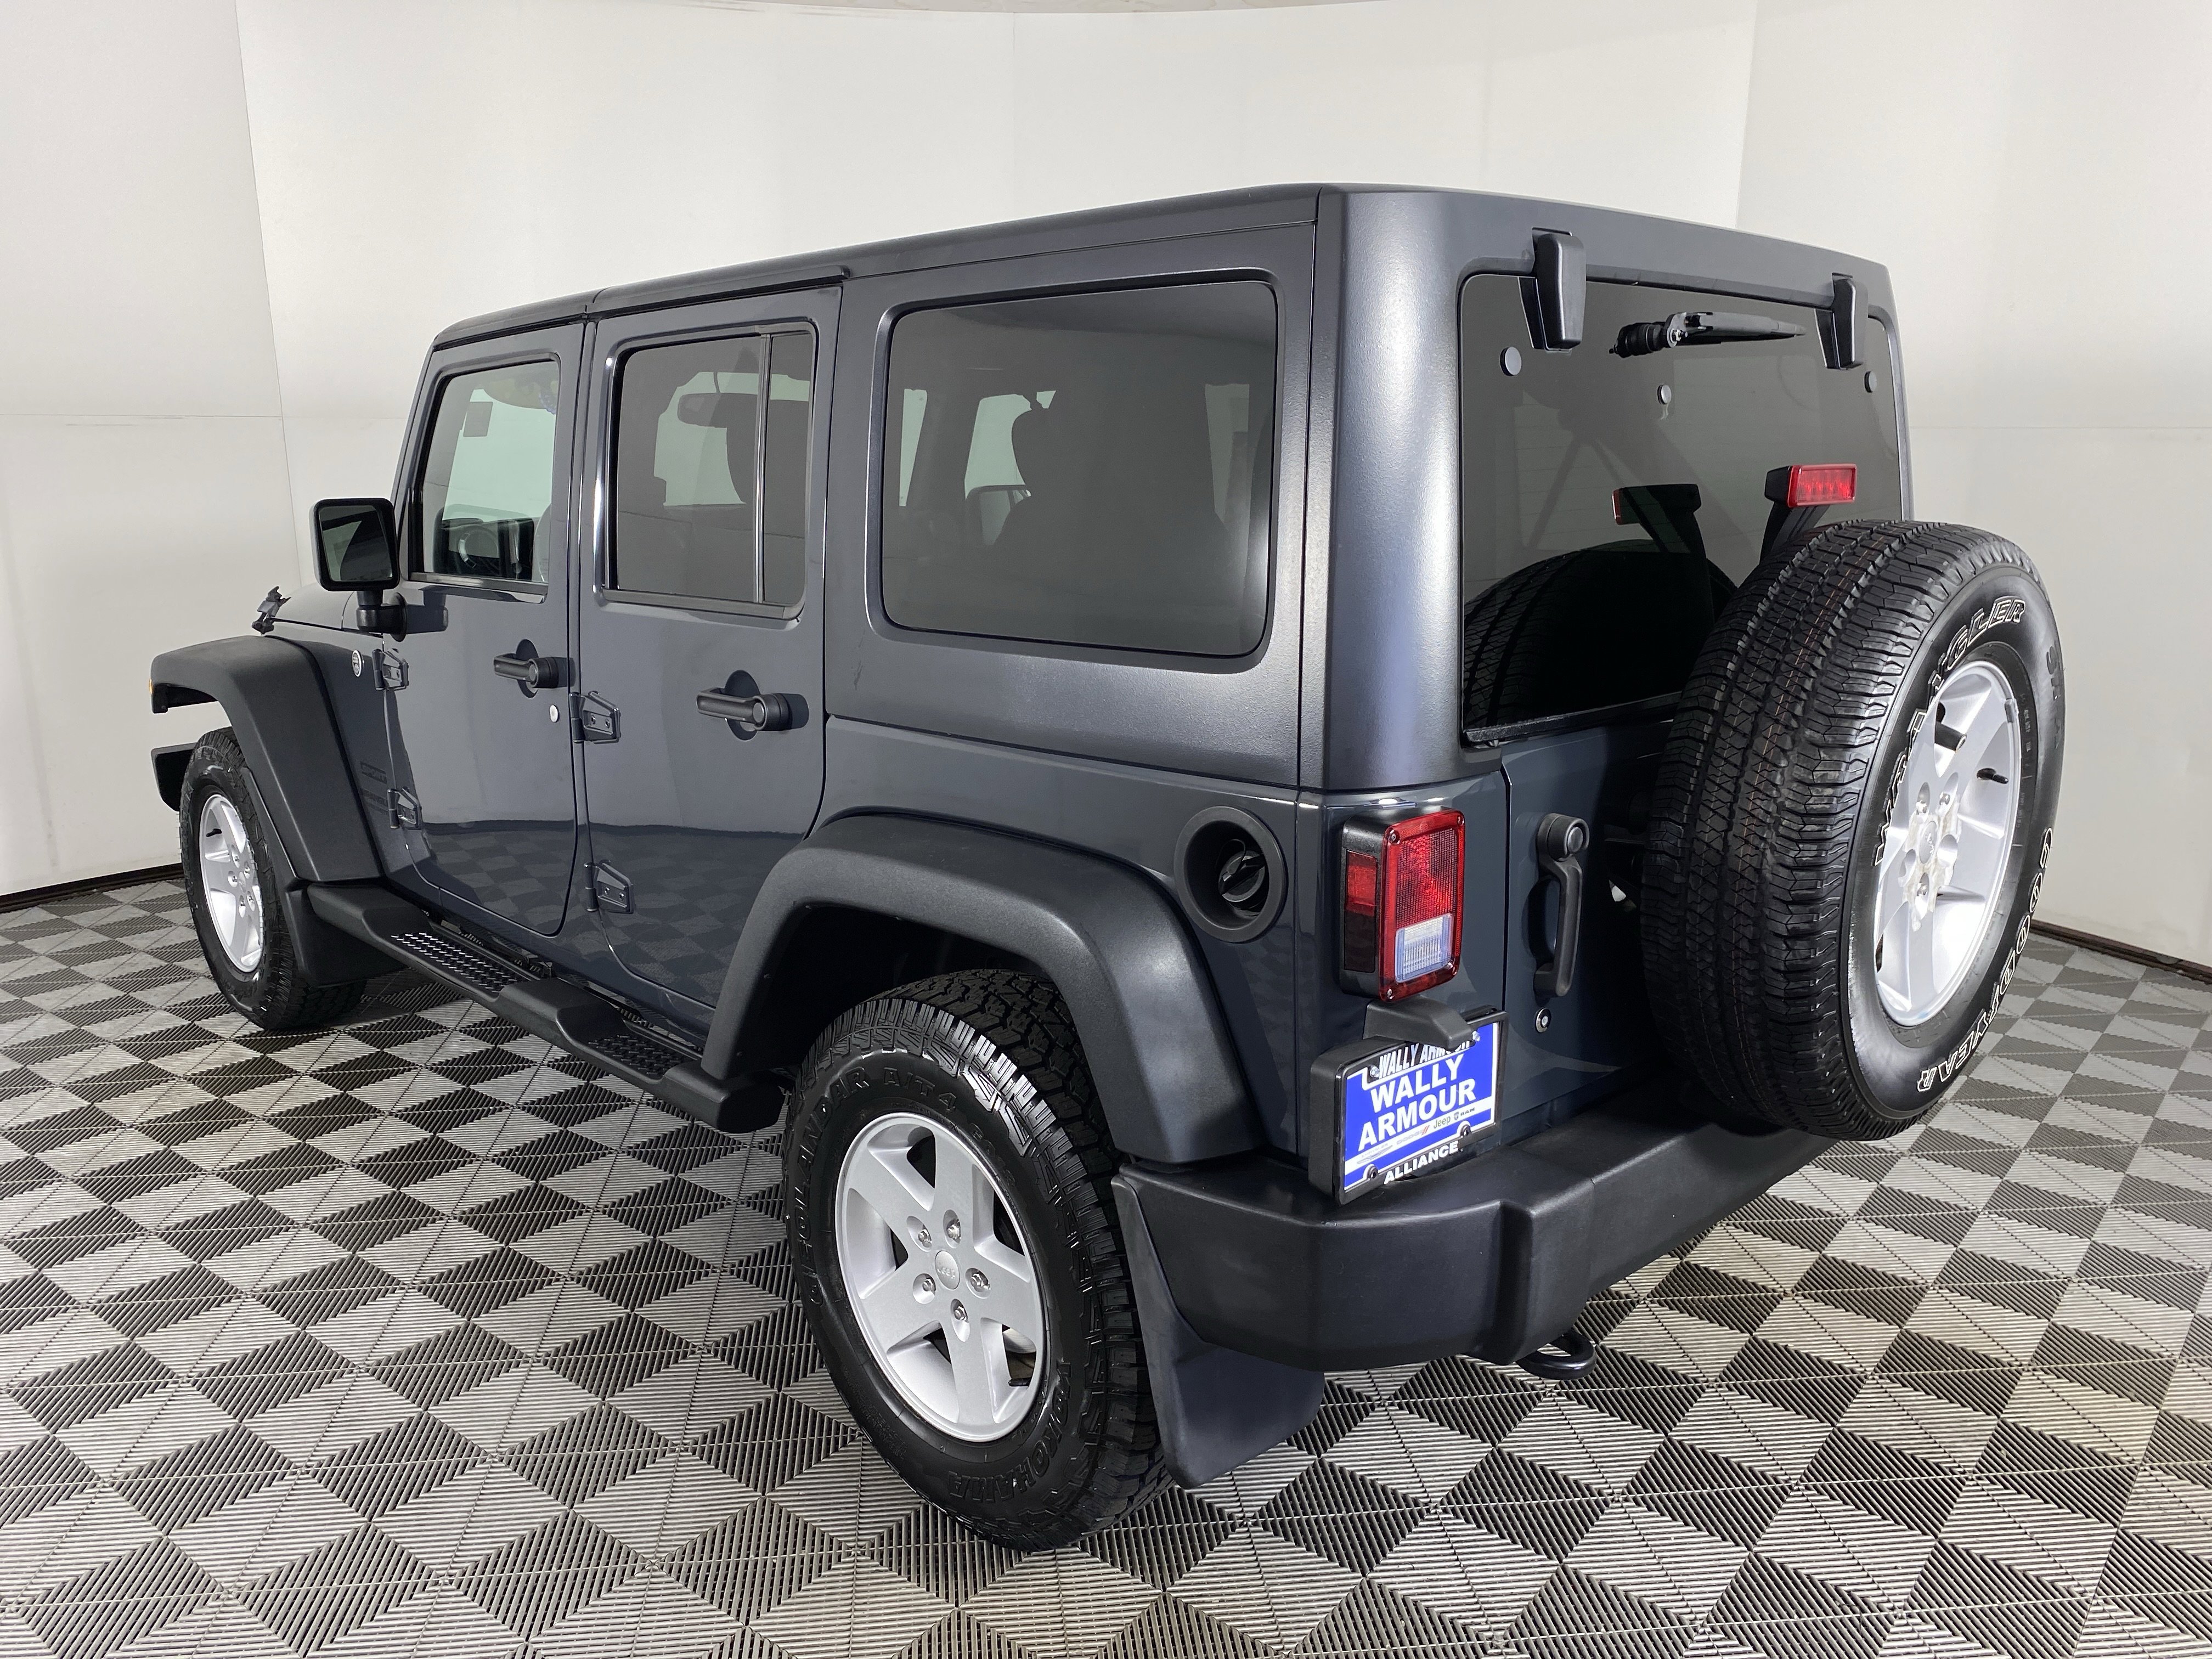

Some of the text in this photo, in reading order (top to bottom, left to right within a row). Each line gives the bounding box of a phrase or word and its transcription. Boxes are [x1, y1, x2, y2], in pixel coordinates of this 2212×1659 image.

[1917, 827, 2052, 1092] GOODYEAR
[1370, 1053, 1464, 1114] WALLY
[1379, 1040, 1470, 1079] WALLY ARM
[1358, 1078, 1476, 1152] ARMOUR
[1433, 1116, 1451, 1129] Jeep
[1460, 1107, 1475, 1117] RAM
